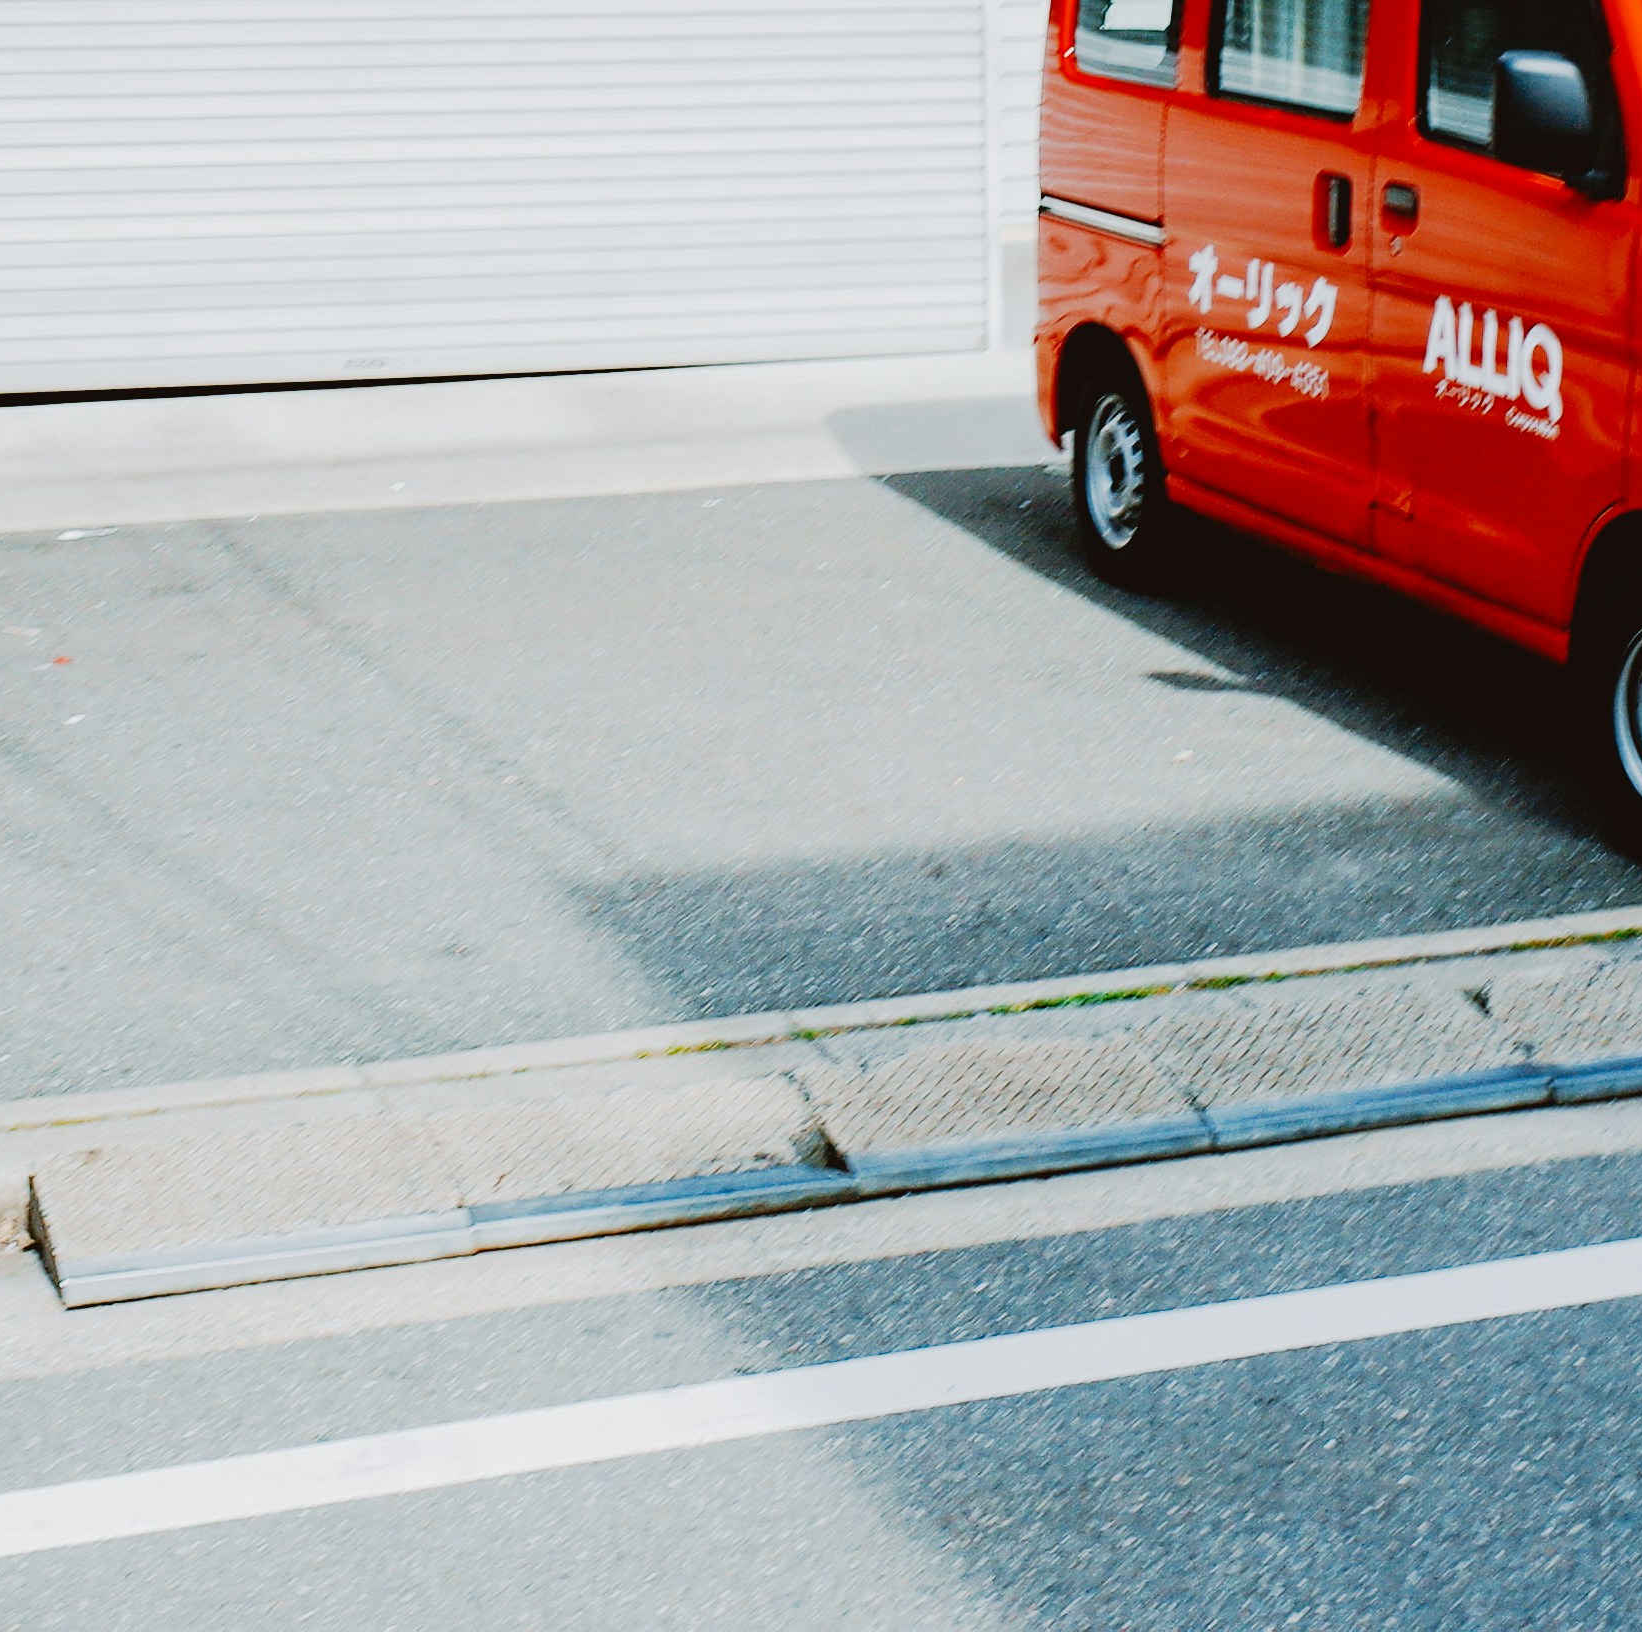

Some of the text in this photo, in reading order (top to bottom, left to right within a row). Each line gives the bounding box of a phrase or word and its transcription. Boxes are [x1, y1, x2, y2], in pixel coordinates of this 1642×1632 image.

[1188, 243, 1339, 348] オーリック
[1422, 294, 1564, 424] ALLIQ
